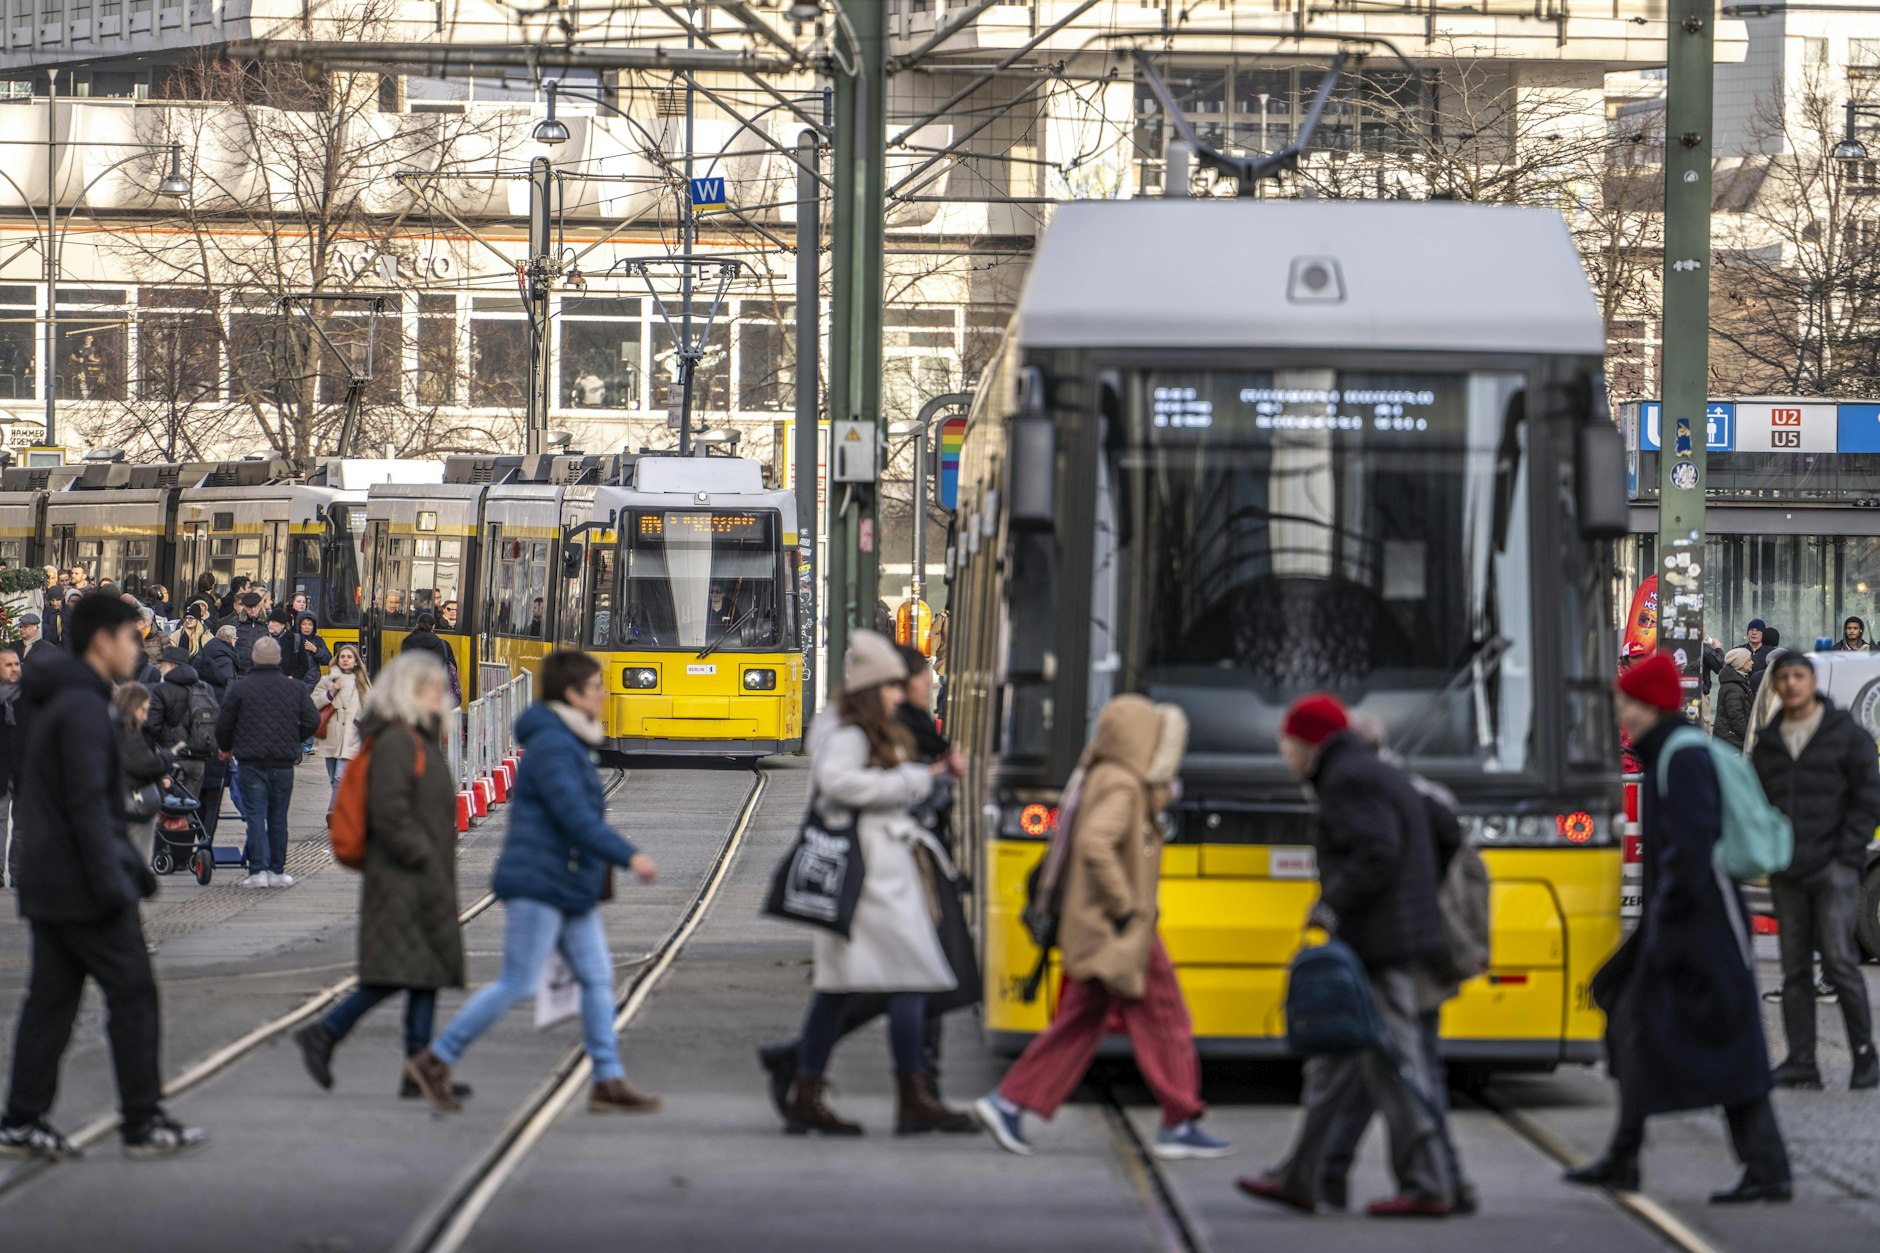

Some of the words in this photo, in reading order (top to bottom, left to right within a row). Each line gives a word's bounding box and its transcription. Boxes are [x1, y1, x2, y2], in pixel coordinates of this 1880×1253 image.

[696, 180, 719, 202] W
[1774, 411, 1799, 425] U2
[11, 429, 45, 437] HAMMER
[1774, 432, 1799, 447] U5
[641, 516, 661, 533] M4
